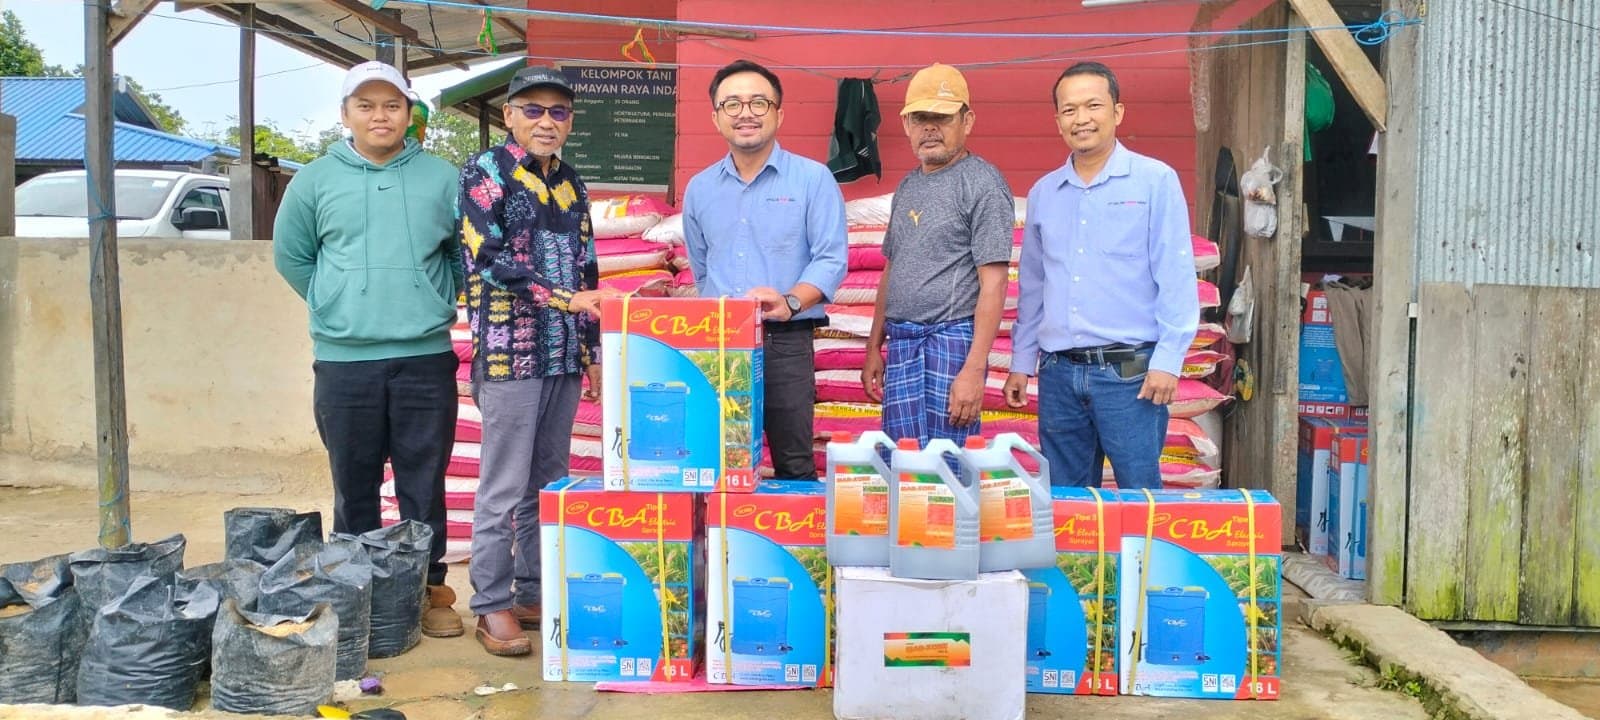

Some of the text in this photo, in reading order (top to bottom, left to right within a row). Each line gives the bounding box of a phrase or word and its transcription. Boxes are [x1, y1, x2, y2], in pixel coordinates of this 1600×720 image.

[581, 69, 671, 80] KELOMPOK TANI
[570, 83, 618, 94] UMAYAN
[621, 84, 649, 95] RAYA
[650, 314, 711, 336] CBA
[684, 471, 697, 480] SNI
[726, 474, 751, 487] 16 L
[646, 503, 661, 512] Tip
[814, 507, 826, 516] Tip
[587, 507, 648, 528] CBA
[754, 511, 815, 531] CBA
[1169, 519, 1233, 540] CBA
[621, 661, 634, 671] SNI
[680, 666, 689, 677] L
[786, 666, 799, 676] SNI
[1044, 673, 1057, 683] SNI
[1204, 677, 1217, 687] SNI
[1105, 678, 1114, 691] L
[1267, 682, 1276, 695] L
